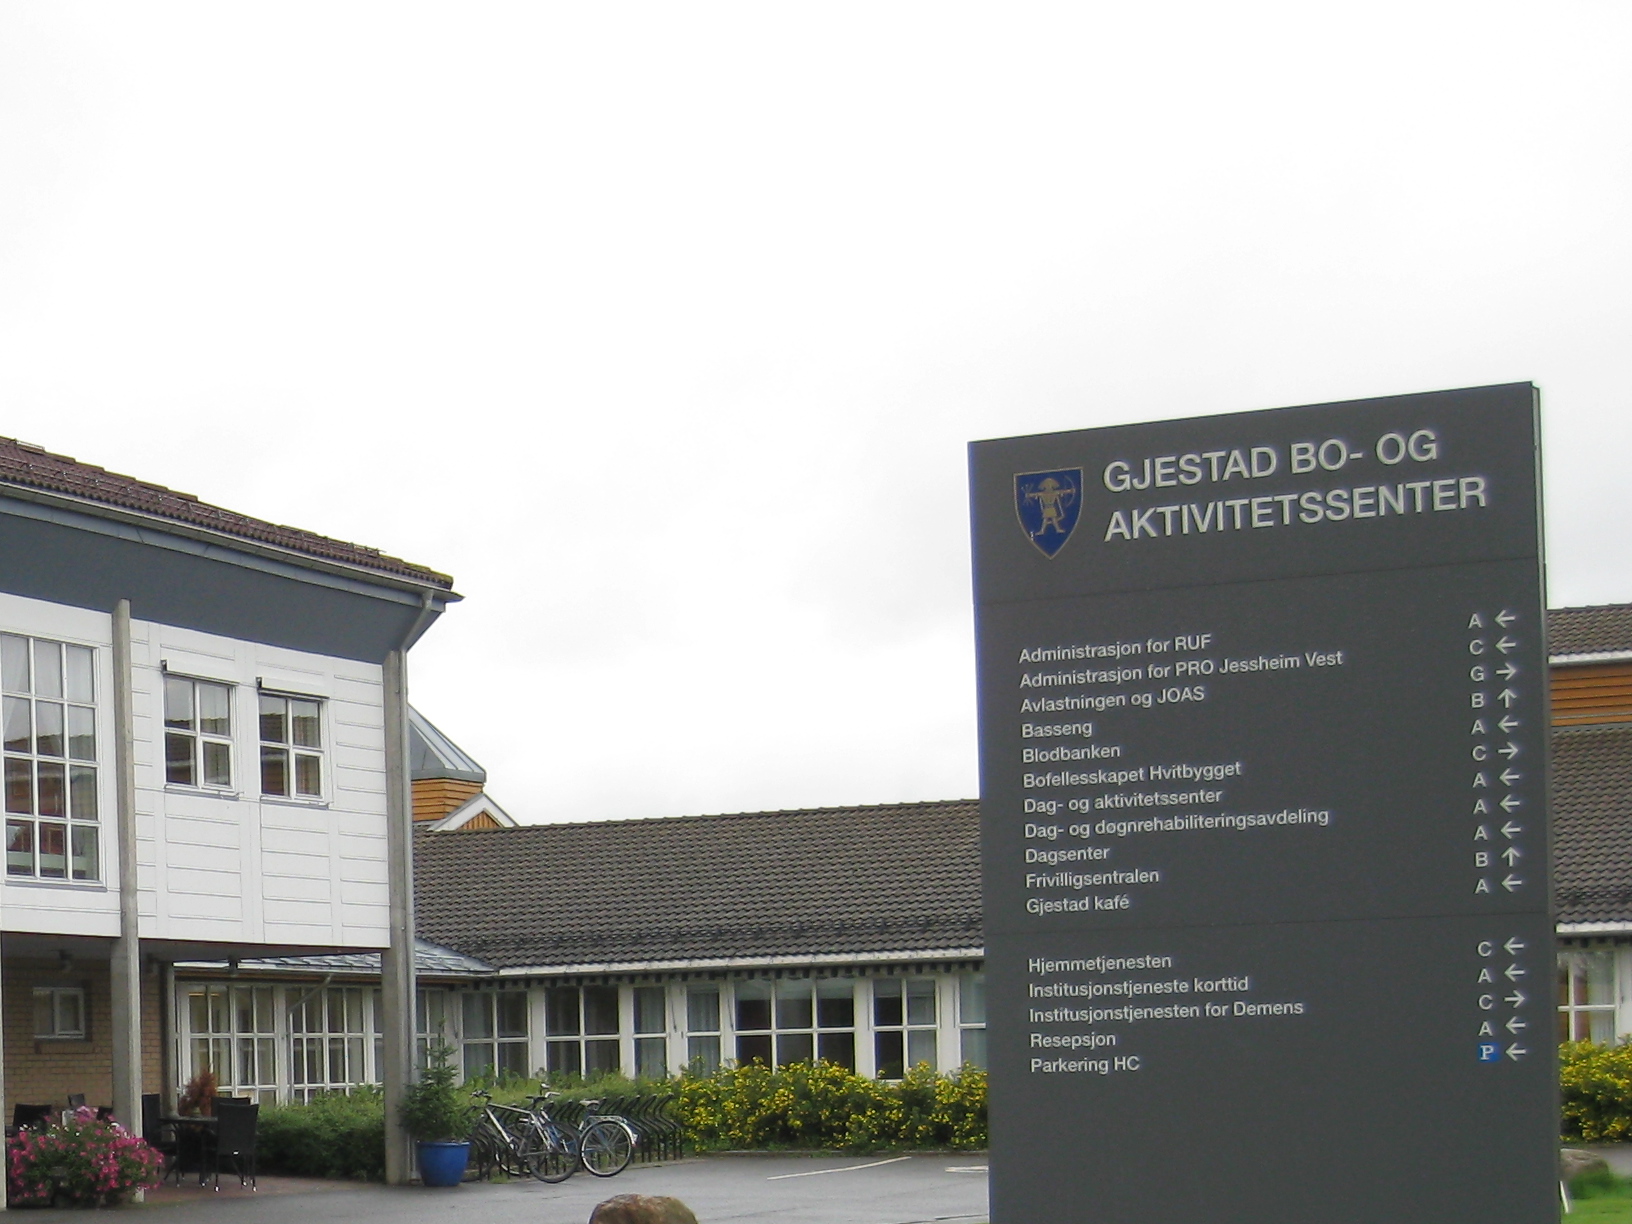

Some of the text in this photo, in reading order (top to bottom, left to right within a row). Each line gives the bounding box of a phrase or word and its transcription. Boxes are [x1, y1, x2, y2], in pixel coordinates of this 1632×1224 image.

[1103, 428, 1439, 492] GJESTAD BO- OG
[1104, 475, 1488, 542] AKTIVITETSSENTER
[1468, 613, 1483, 629] A
[1018, 632, 1212, 664] Administrasjon for RUF
[1469, 639, 1485, 656] C
[1019, 650, 1344, 689] Administrasjon for PRO Jessheim Vest
[1470, 665, 1487, 682] G
[1020, 685, 1206, 714] Avlastningen og JOAS
[1471, 692, 1486, 709] B
[1021, 722, 1093, 739] Basseng
[1471, 718, 1486, 735] A
[1022, 743, 1121, 764] Blodbanken
[1472, 745, 1487, 762] C
[1023, 761, 1243, 789] Bofellesskapet Hvitbygget
[1472, 772, 1488, 788] A
[1023, 788, 1224, 816] Dag- og aktivitetssenter
[1472, 798, 1488, 815] A
[1024, 807, 1330, 841] Dag- og døgnrehabiliteringsavdeling
[1473, 824, 1489, 841] A
[1025, 846, 1111, 866] Dagsenter
[1475, 851, 1490, 868] B
[1025, 868, 1160, 890] Frivilligsentralen
[1474, 878, 1490, 894] A
[1026, 893, 1131, 917] Gjestad kafé
[1477, 940, 1493, 957] C
[1028, 954, 1173, 977] Hjemmetjenesten
[1477, 968, 1493, 984] A
[1029, 975, 1249, 1000] Institusjonstjeneste korttid
[1478, 994, 1494, 1010] C
[1029, 1000, 1305, 1025] Institusjonstjenesten for Demens
[1478, 1020, 1494, 1037] A
[1030, 1031, 1117, 1051] Resepsjon
[1479, 1044, 1495, 1061] P
[1030, 1055, 1141, 1075] Parkering HC
